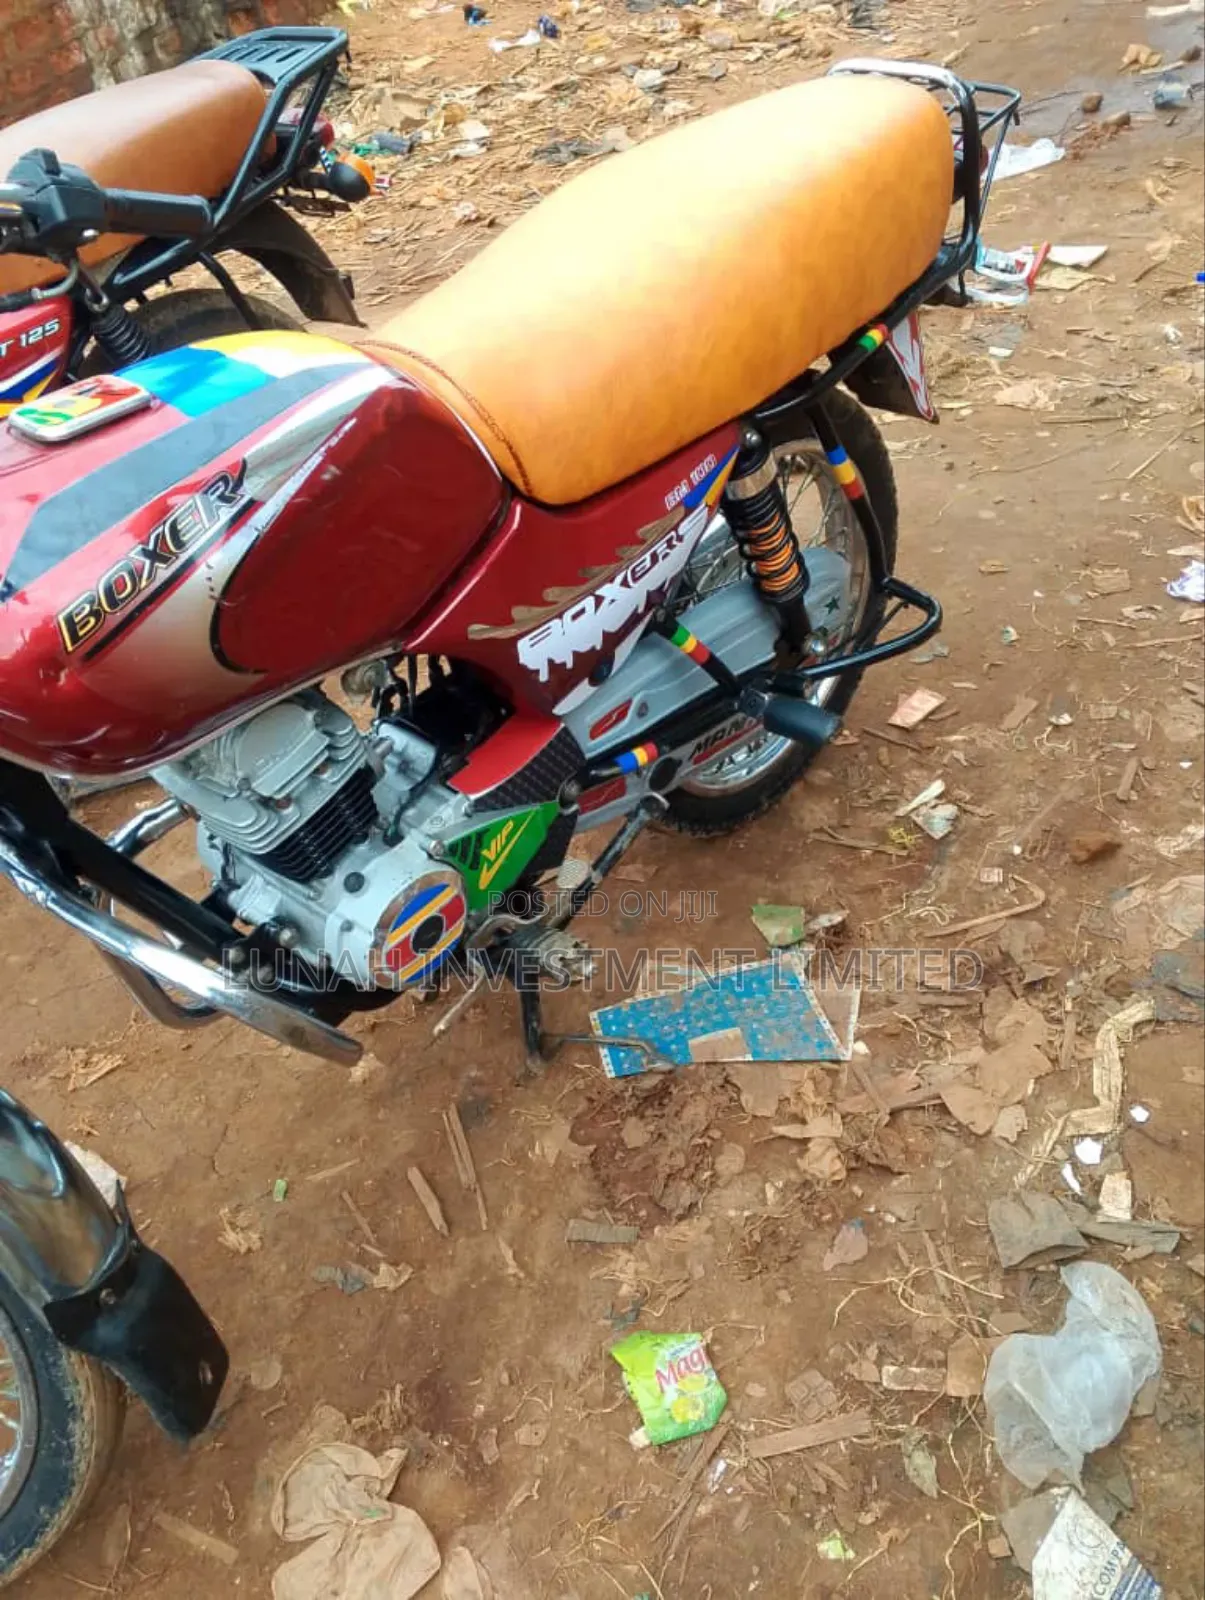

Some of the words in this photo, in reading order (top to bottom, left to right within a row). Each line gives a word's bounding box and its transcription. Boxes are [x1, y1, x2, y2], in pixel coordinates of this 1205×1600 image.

[20, 318, 60, 347] 125
[690, 453, 717, 486] 100
[57, 457, 247, 653] BOXER
[481, 820, 514, 862] VIP
